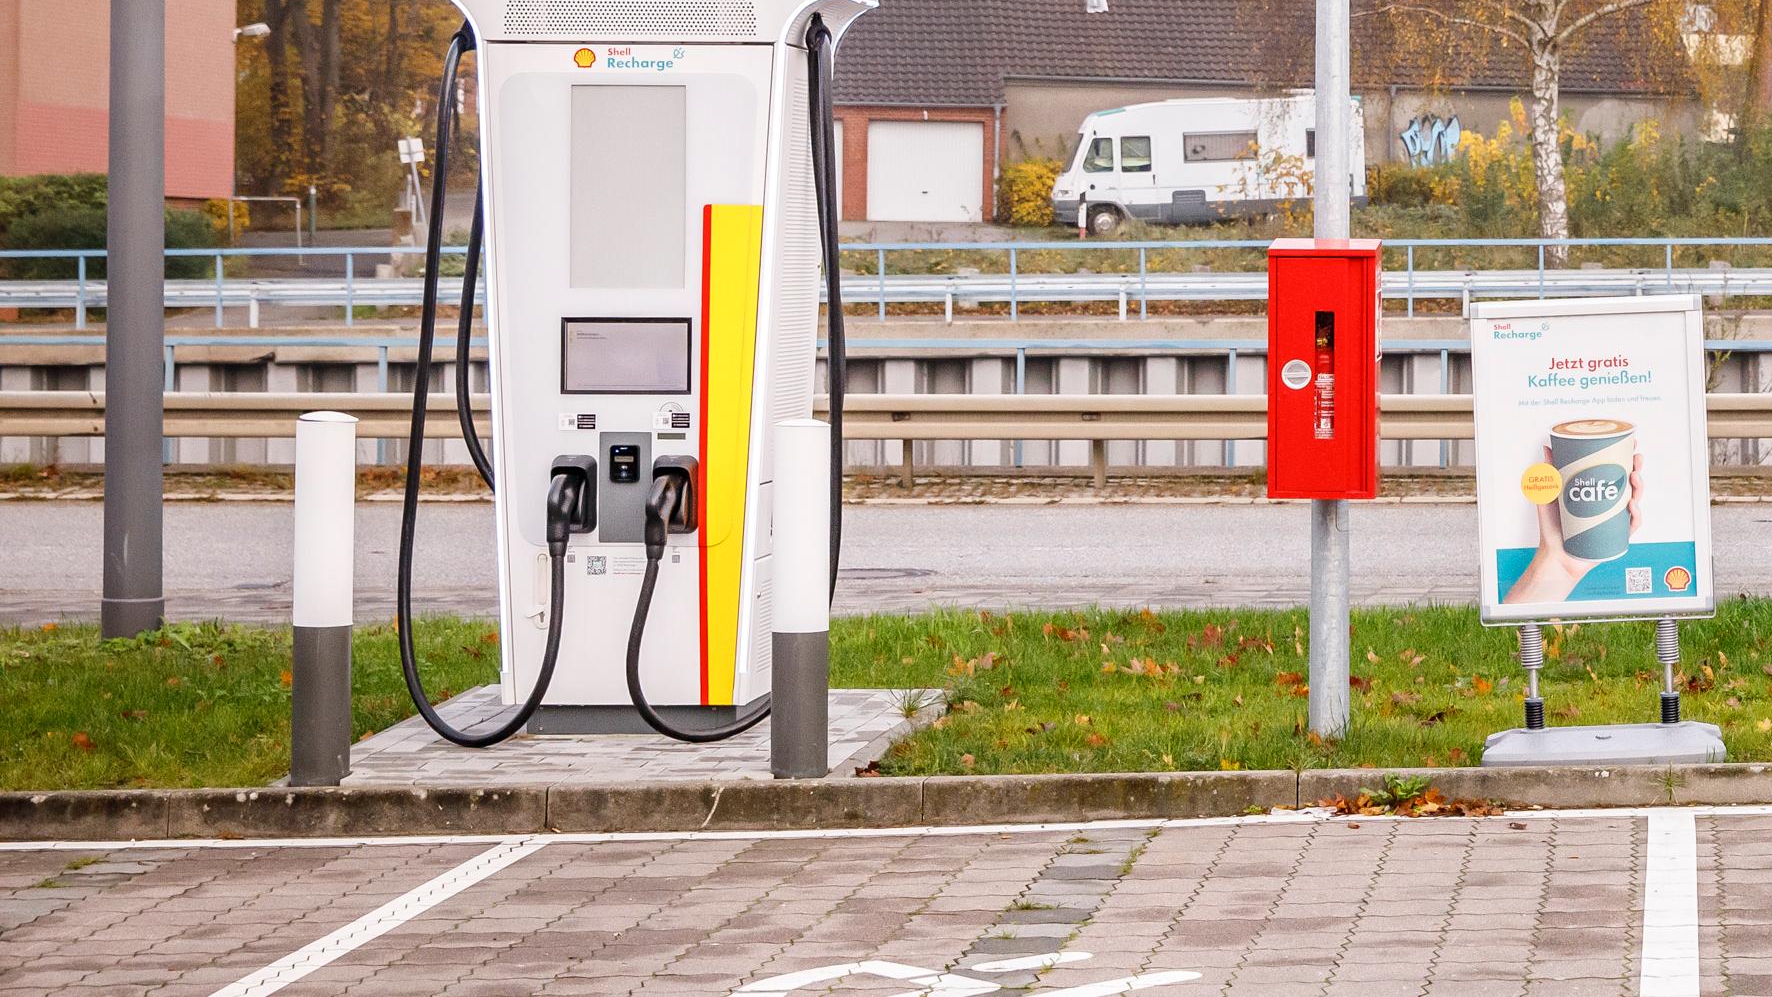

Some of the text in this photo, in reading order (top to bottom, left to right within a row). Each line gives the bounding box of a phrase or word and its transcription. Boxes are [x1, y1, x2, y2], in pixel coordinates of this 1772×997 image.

[607, 57, 673, 71] Recharge
[1493, 330, 1542, 340] Recharge
[1548, 355, 1629, 372] Jetzt gratis
[1528, 370, 1652, 389] Kaffee genießen!
[1560, 397, 1590, 405] Recharge
[1592, 397, 1606, 405] App
[1574, 478, 1596, 487] Shell
[1568, 479, 1619, 502] café
